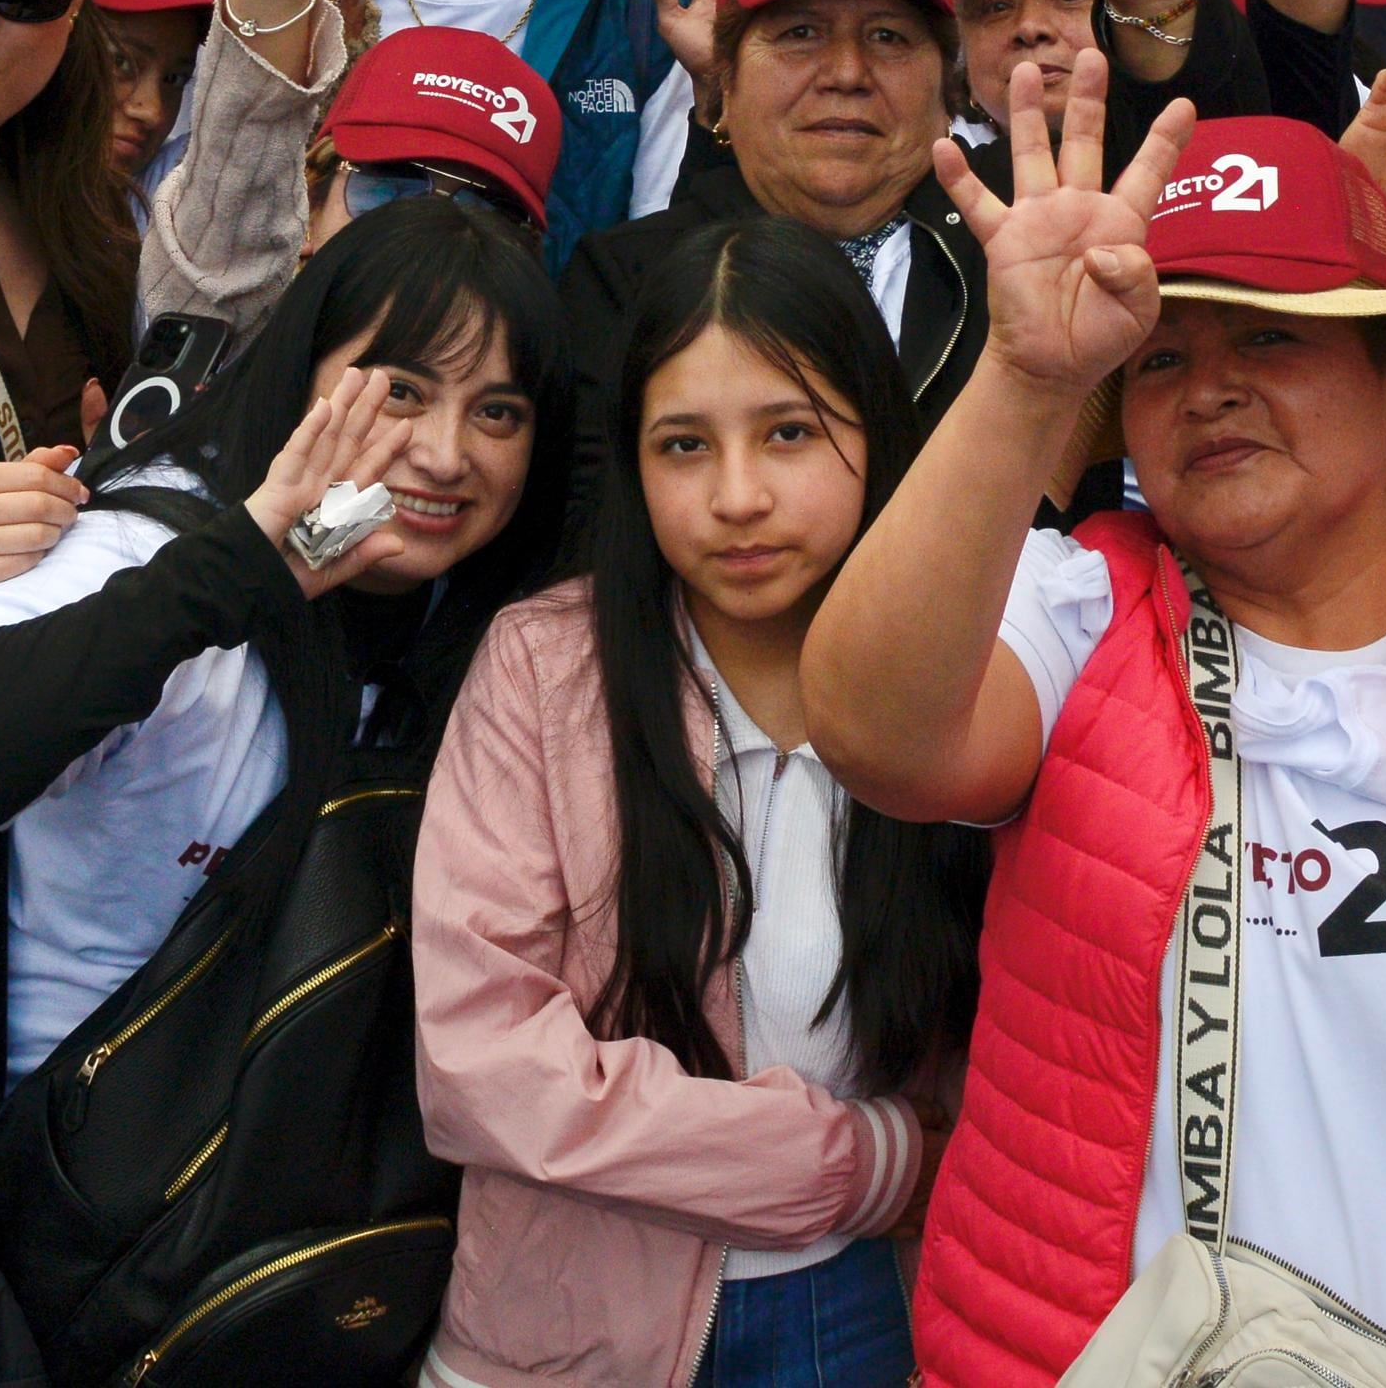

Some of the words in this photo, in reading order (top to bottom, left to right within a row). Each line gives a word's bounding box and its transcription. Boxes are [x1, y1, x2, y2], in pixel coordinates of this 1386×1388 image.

[412, 72, 506, 110] PROYECTO
[490, 86, 537, 144] 21
[568, 90, 613, 102] NORTH
[581, 101, 613, 113] FACE
[585, 78, 613, 91] THE
[1151, 172, 1223, 203] YECTO
[1211, 153, 1279, 213] 21
[1183, 582, 1234, 761] BIMBA
[1190, 822, 1235, 986] LOLA
[1186, 997, 1230, 1046] Y
[1184, 1062, 1228, 1251] IMBA
